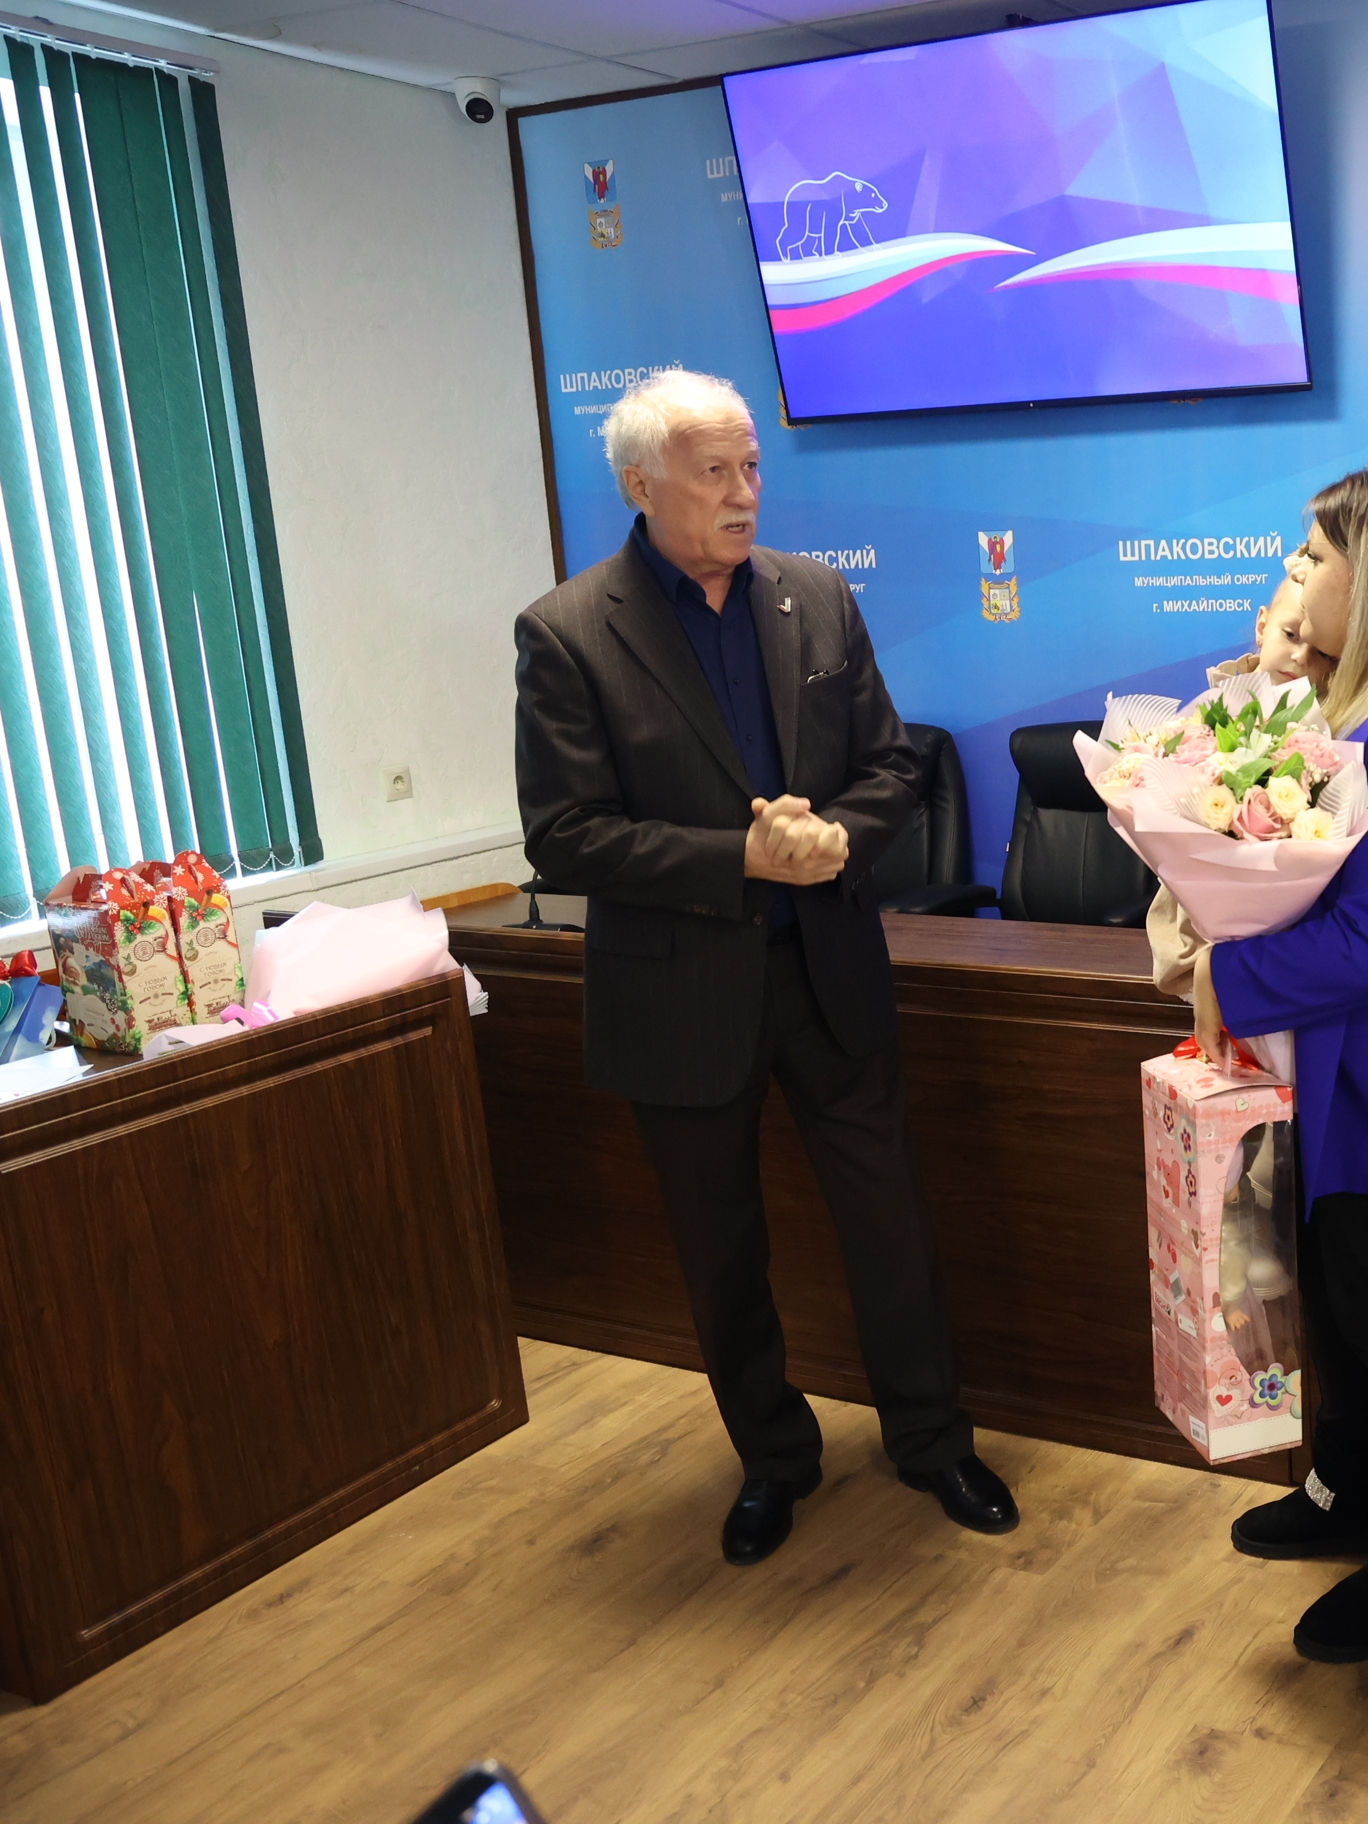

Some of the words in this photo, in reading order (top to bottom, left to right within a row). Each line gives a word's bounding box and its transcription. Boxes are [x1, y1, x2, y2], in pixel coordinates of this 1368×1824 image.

[1118, 530, 1282, 562] ШПАКОВСКИЙ
[787, 544, 876, 570] ВСКИЙ
[1134, 573, 1232, 588] МУНИЦИПАЛЬНЫЙ
[1234, 573, 1269, 585] ОКРУГ
[1153, 603, 1160, 613] г.
[1163, 597, 1252, 613] МИХАЙЛОВСК
